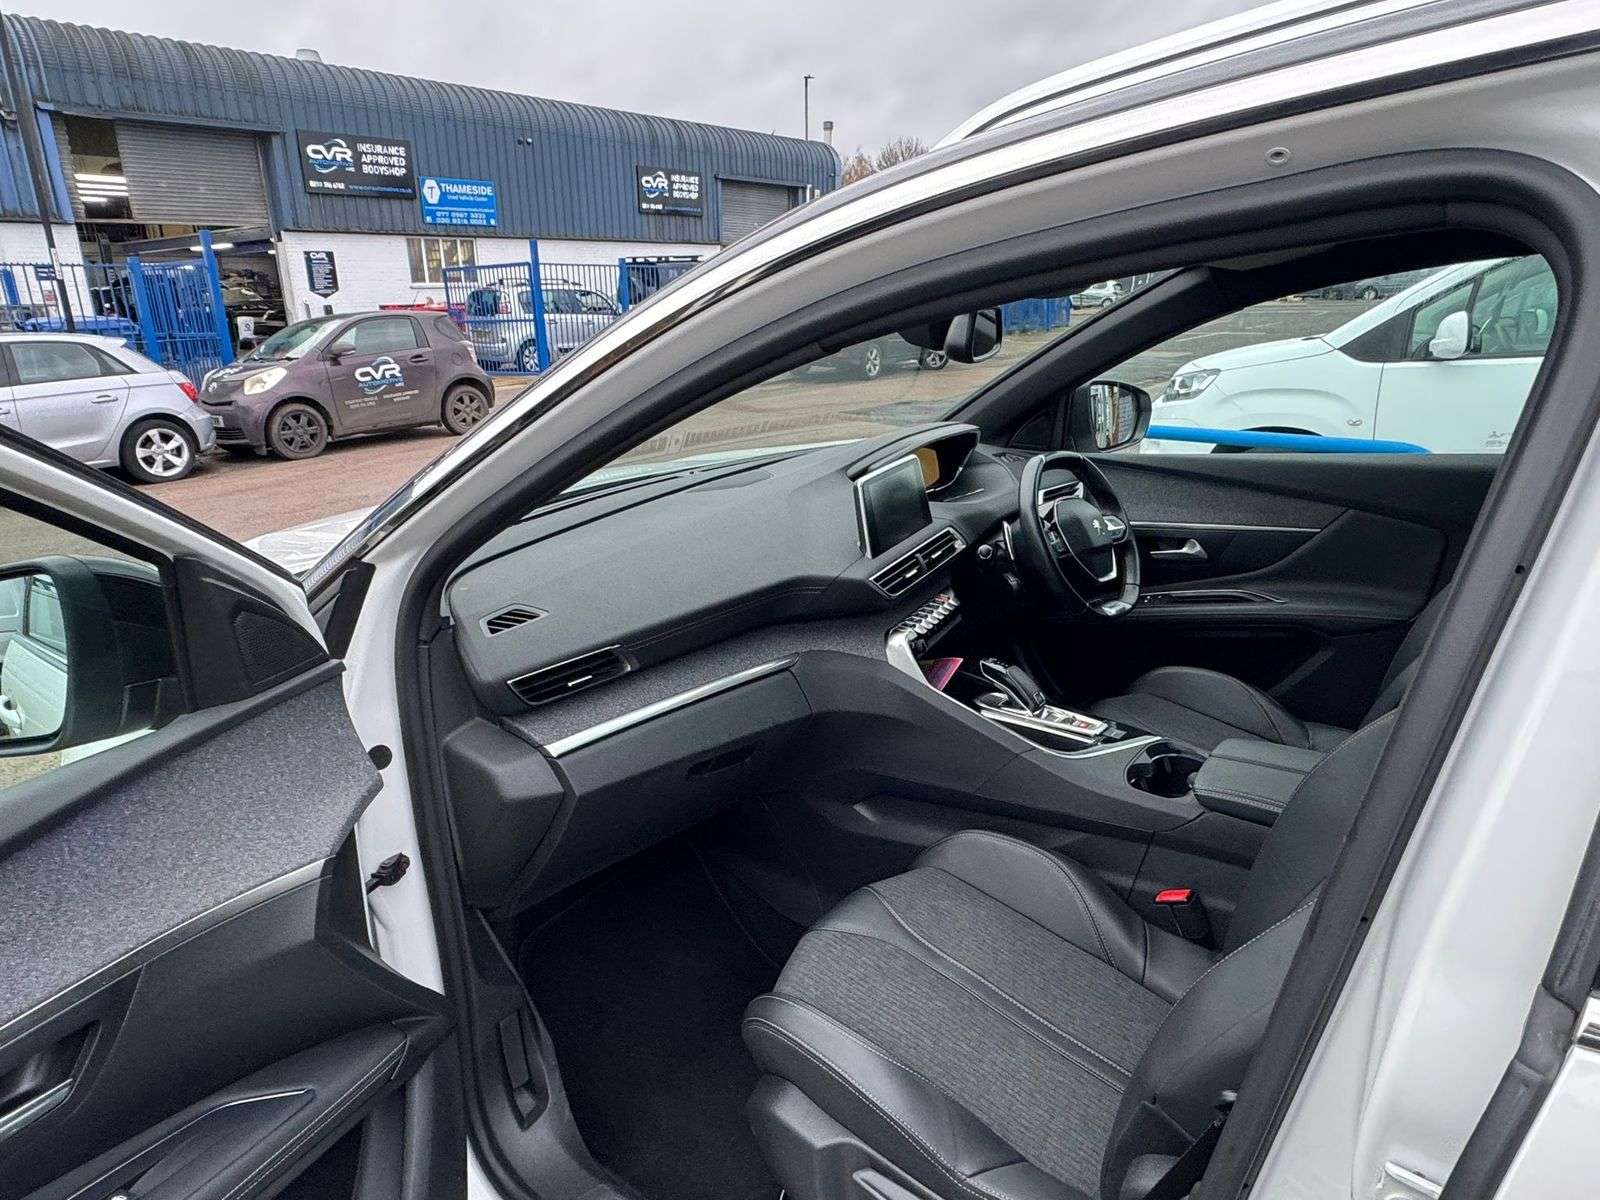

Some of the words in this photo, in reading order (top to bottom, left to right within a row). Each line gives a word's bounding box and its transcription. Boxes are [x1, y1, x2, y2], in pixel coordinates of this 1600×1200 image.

[306, 144, 353, 162] CVR
[357, 143, 406, 157] INSURANCE
[361, 154, 406, 166] APPROVED
[362, 164, 407, 176] BODYSHOP
[641, 176, 668, 189] CVR
[440, 183, 493, 196] THAMESIDE
[354, 363, 402, 382] CVR
